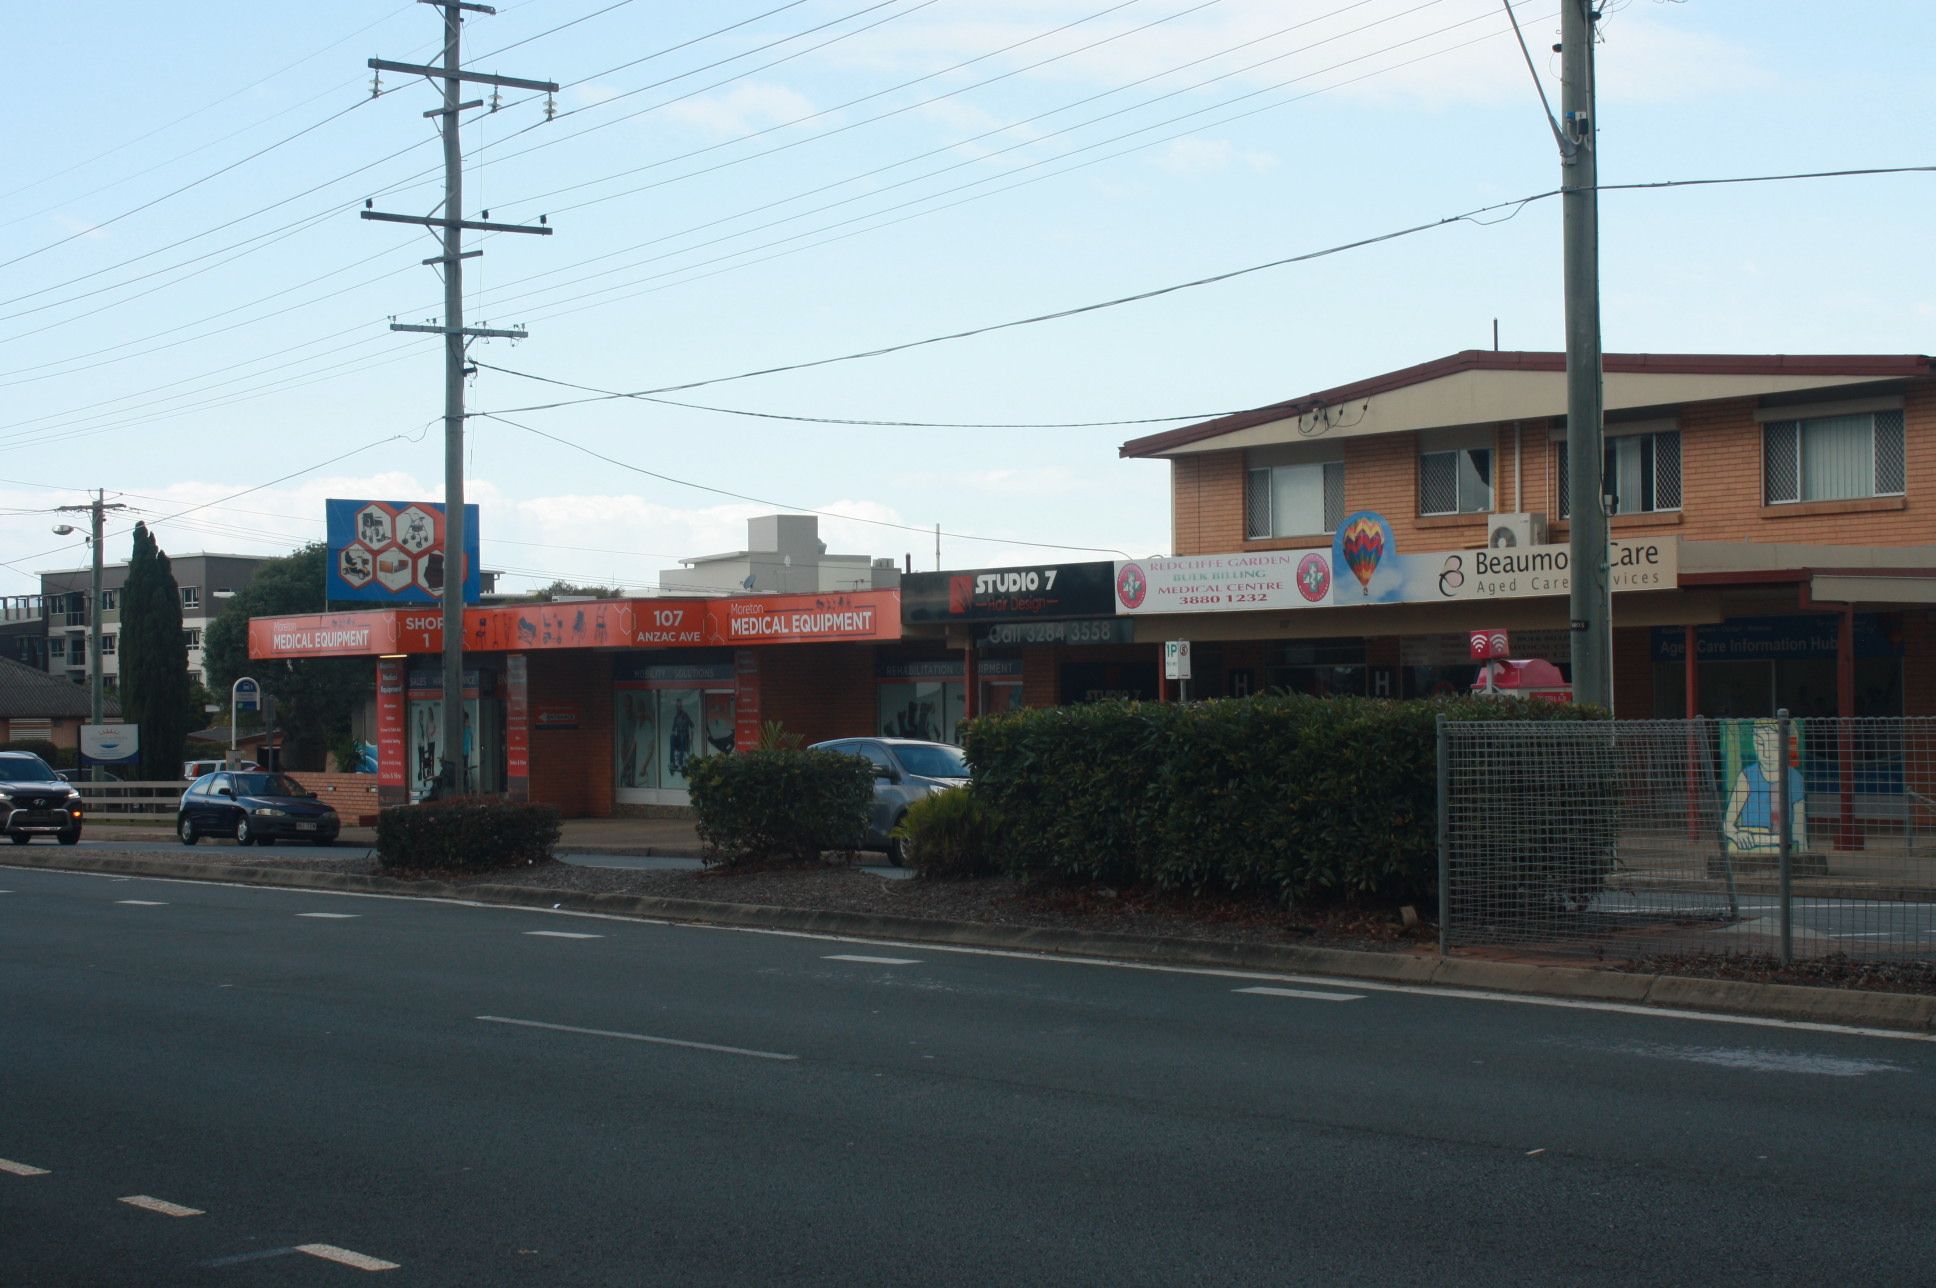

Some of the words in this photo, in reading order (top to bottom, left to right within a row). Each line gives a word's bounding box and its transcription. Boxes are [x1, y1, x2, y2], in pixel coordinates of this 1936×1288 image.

[1150, 561, 1223, 571] REDCLIFFE
[1228, 555, 1290, 568] GARDEN
[1476, 551, 1568, 575] Beaumo
[975, 571, 1039, 594] STUDIO
[1044, 570, 1058, 590] 7
[1211, 570, 1266, 580] BILLING
[1158, 585, 1220, 595] MEDICAL
[1226, 581, 1284, 592] CENTRE
[1476, 579, 1518, 596] Aged
[1531, 576, 1569, 590] Care
[1613, 572, 1659, 585] vices
[1179, 595, 1220, 605] 3880
[1225, 593, 1268, 603] 1232
[730, 603, 764, 616] Moreton
[653, 610, 683, 626] 107
[731, 616, 788, 636] MEDICAL
[791, 611, 872, 633] EQUIPMENT
[273, 633, 312, 649] MEDICAL
[314, 630, 369, 648] EQUIPMENT
[422, 633, 429, 648] 1
[636, 632, 676, 642] ANZAC
[680, 631, 701, 642] AVE
[990, 623, 1020, 644] Call
[1026, 622, 1065, 642] 3284
[1070, 621, 1111, 641] 3558
[1167, 644, 1178, 658] 1P
[1661, 641, 1687, 656] Age
[1697, 640, 1727, 653] Care
[1730, 636, 1807, 653] Information
[1811, 636, 1838, 651] Hub
[885, 663, 954, 676] REHABILITATION
